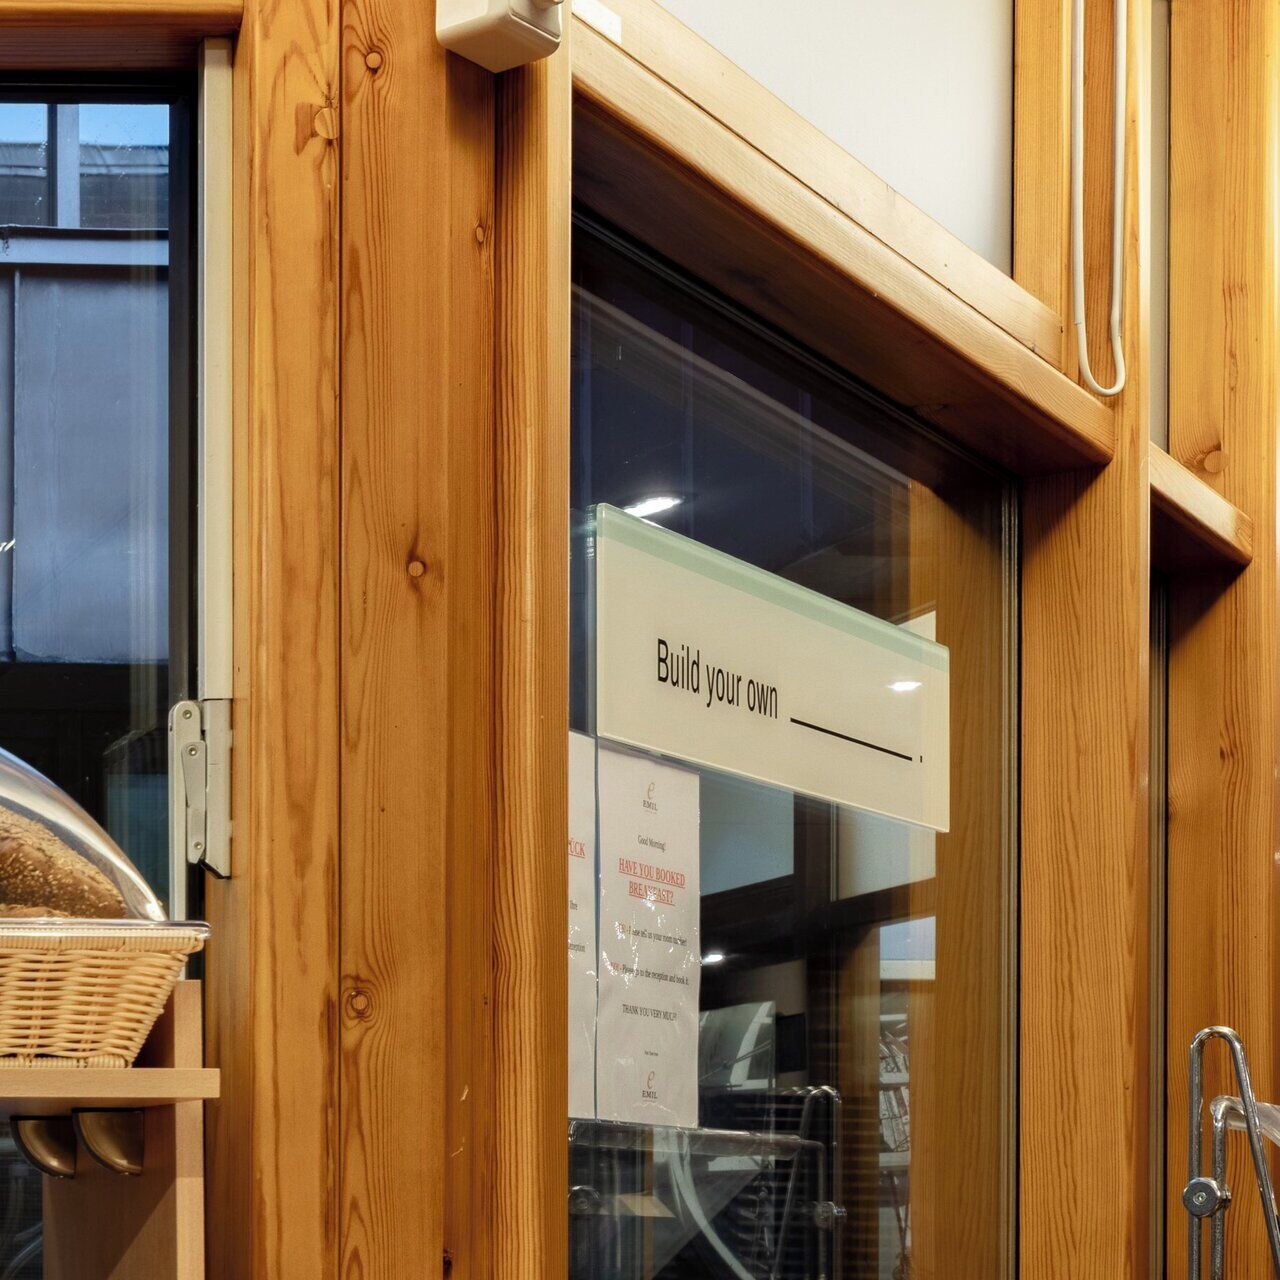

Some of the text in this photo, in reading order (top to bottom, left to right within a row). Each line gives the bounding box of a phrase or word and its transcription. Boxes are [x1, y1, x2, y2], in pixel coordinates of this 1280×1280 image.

[656, 638, 779, 719] Build your own
[568, 838, 586, 857] ÜCK
[619, 857, 686, 887] HAVE YOU BOOKED
[622, 1004, 639, 1015] THANK
[639, 1007, 649, 1017] YOU
[650, 1008, 662, 1019] VERY
[642, 1090, 658, 1099] EMIL
